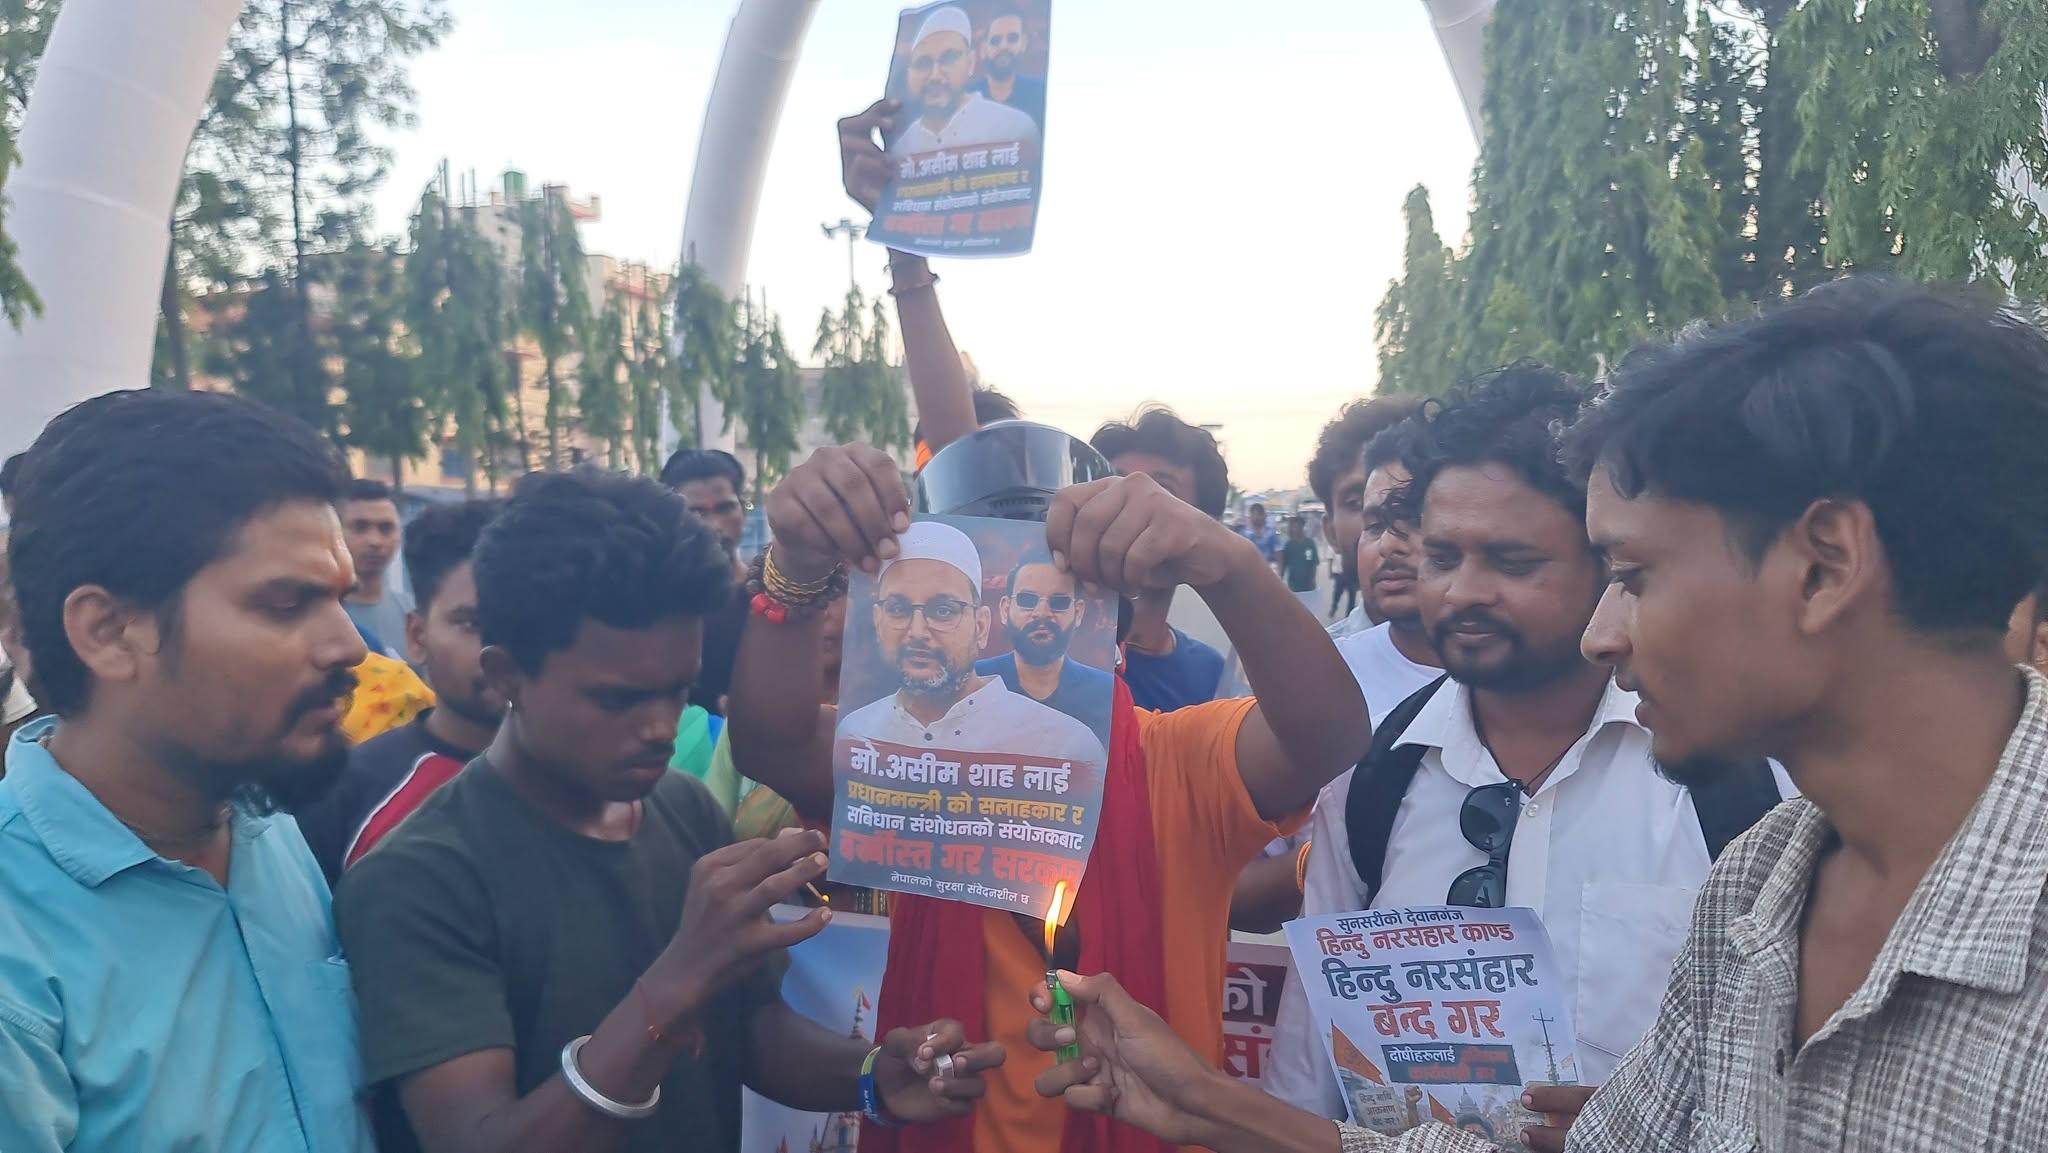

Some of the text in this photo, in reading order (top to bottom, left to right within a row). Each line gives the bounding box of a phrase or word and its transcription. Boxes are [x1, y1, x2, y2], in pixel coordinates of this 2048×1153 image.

[968, 763, 1016, 788] शाह
[1023, 762, 1071, 794] लाई
[847, 780, 1085, 825] प्रधानमन्त्री को सलाहकार र
[847, 804, 1084, 851] सबिधान संशोधनको संयोजकबाट
[940, 843, 985, 875] गर
[891, 870, 1030, 905] नेपालको सुरक्षा संवेदनशील छ
[1336, 907, 1464, 934] सुनसरीको देवानगंज
[1315, 928, 1370, 960] हिन्दु
[1458, 923, 1514, 942] काण्ड
[1321, 948, 1538, 1003] हिन्दु नरसंहार
[1366, 1000, 1506, 1040] बन्द गर
